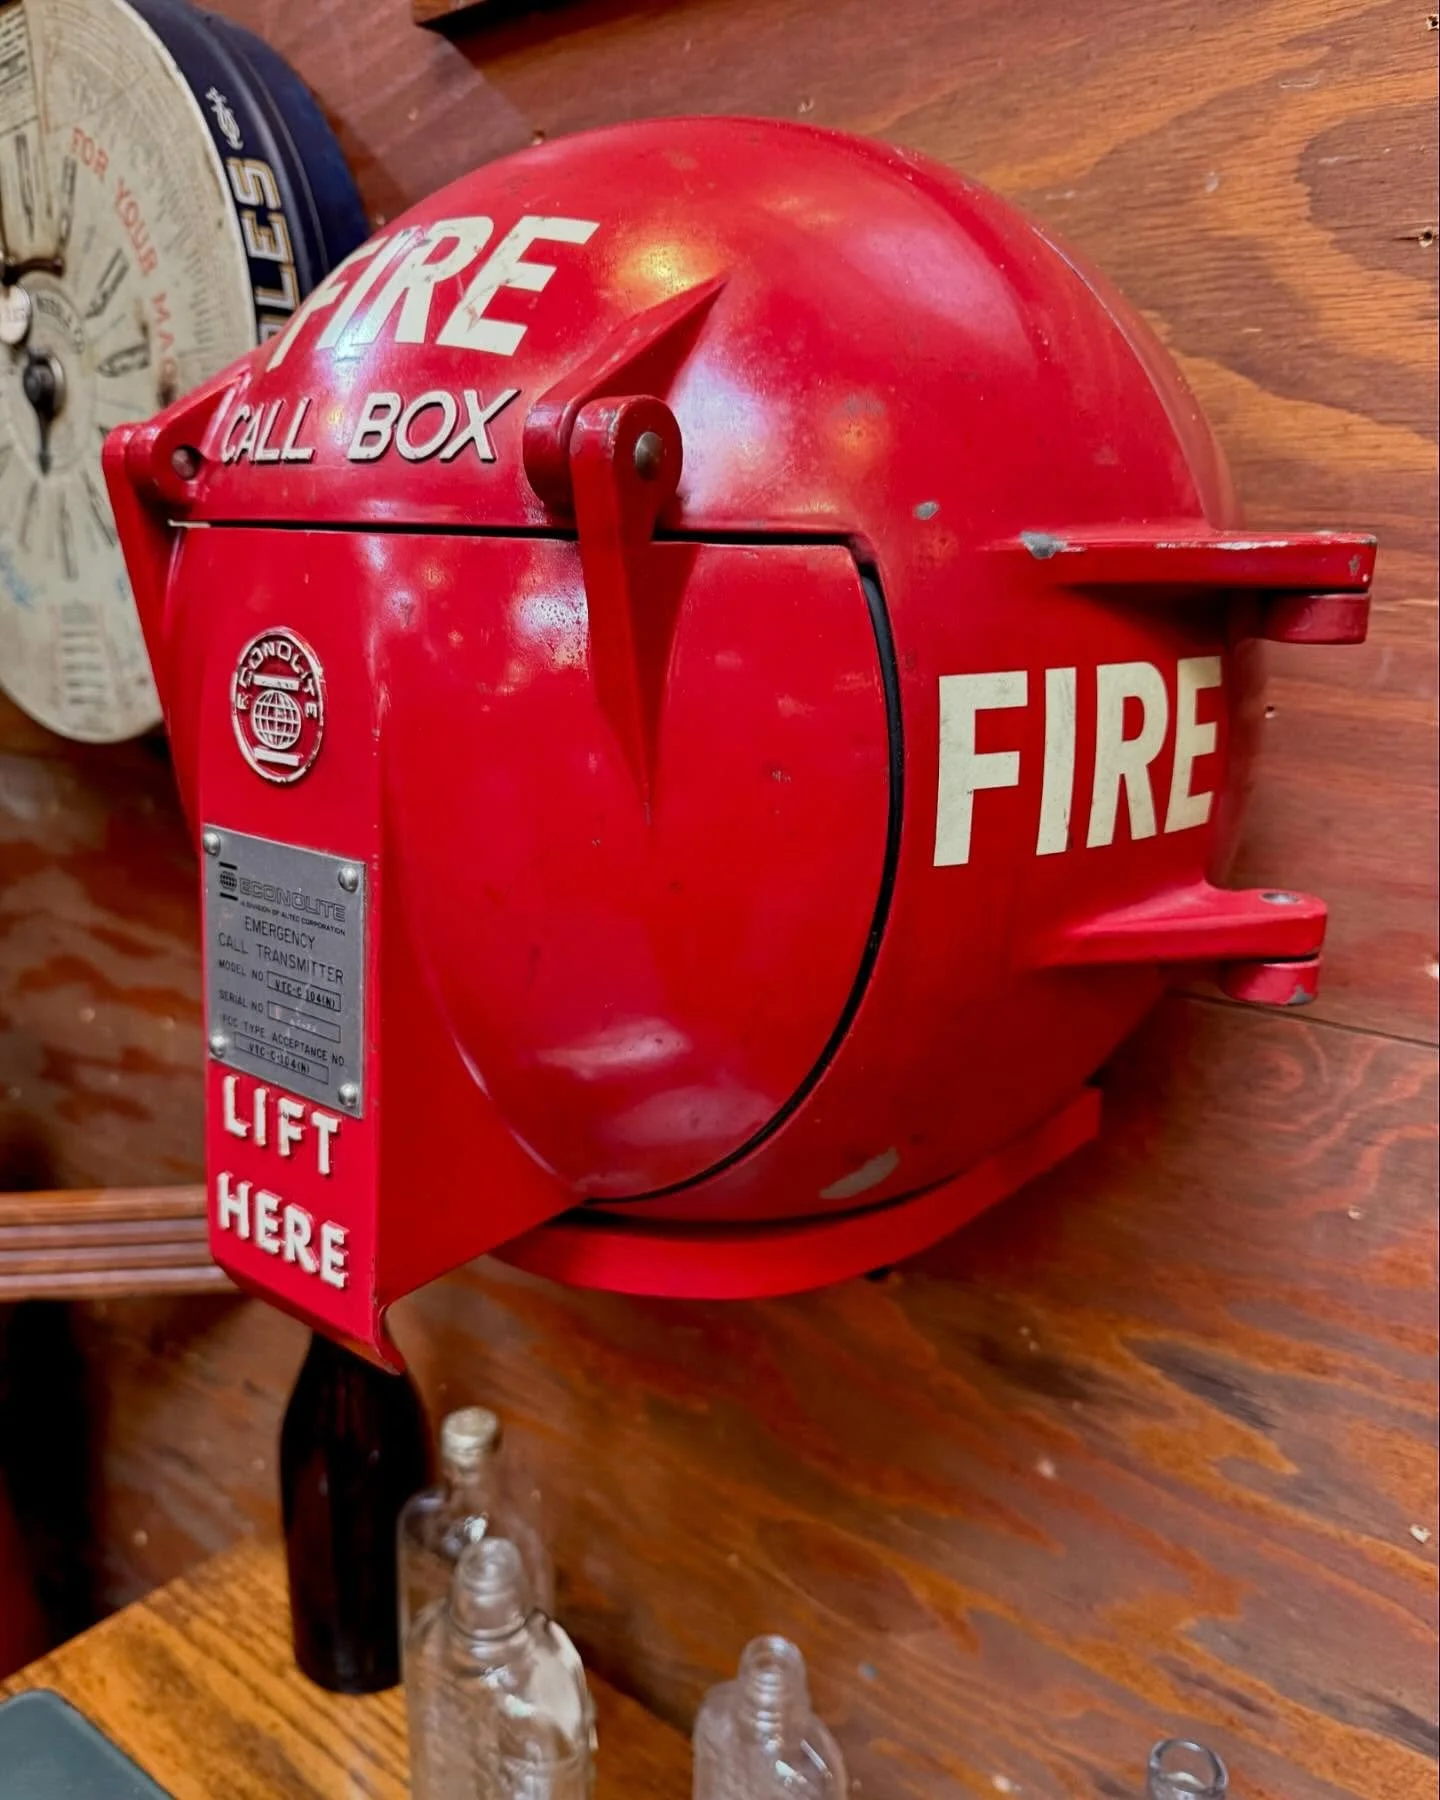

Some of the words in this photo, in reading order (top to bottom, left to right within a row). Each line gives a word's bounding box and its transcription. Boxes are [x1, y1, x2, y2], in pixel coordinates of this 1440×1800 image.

[73, 126, 109, 181] FOR
[115, 177, 157, 277] YOUR
[266, 215, 600, 372] FIRE
[221, 397, 316, 463] CALL
[346, 389, 521, 463] BOX
[237, 640, 317, 718] ECONOLITE
[933, 655, 1223, 866] FIRE
[239, 877, 346, 922] ECONOLITE
[301, 918, 346, 936] CORPORATION
[218, 932, 248, 954] CALL
[256, 944, 344, 984] TRANSMITTER
[245, 916, 316, 950] EMERGENCY
[218, 959, 247, 976] MODEL
[218, 990, 248, 1008] SERIAL
[222, 1014, 238, 1029] FCC
[244, 1021, 265, 1039] TYPE
[272, 1032, 328, 1061] ACCEPTANCE
[222, 1074, 342, 1175] LIFT
[217, 1170, 350, 1288] HERE
